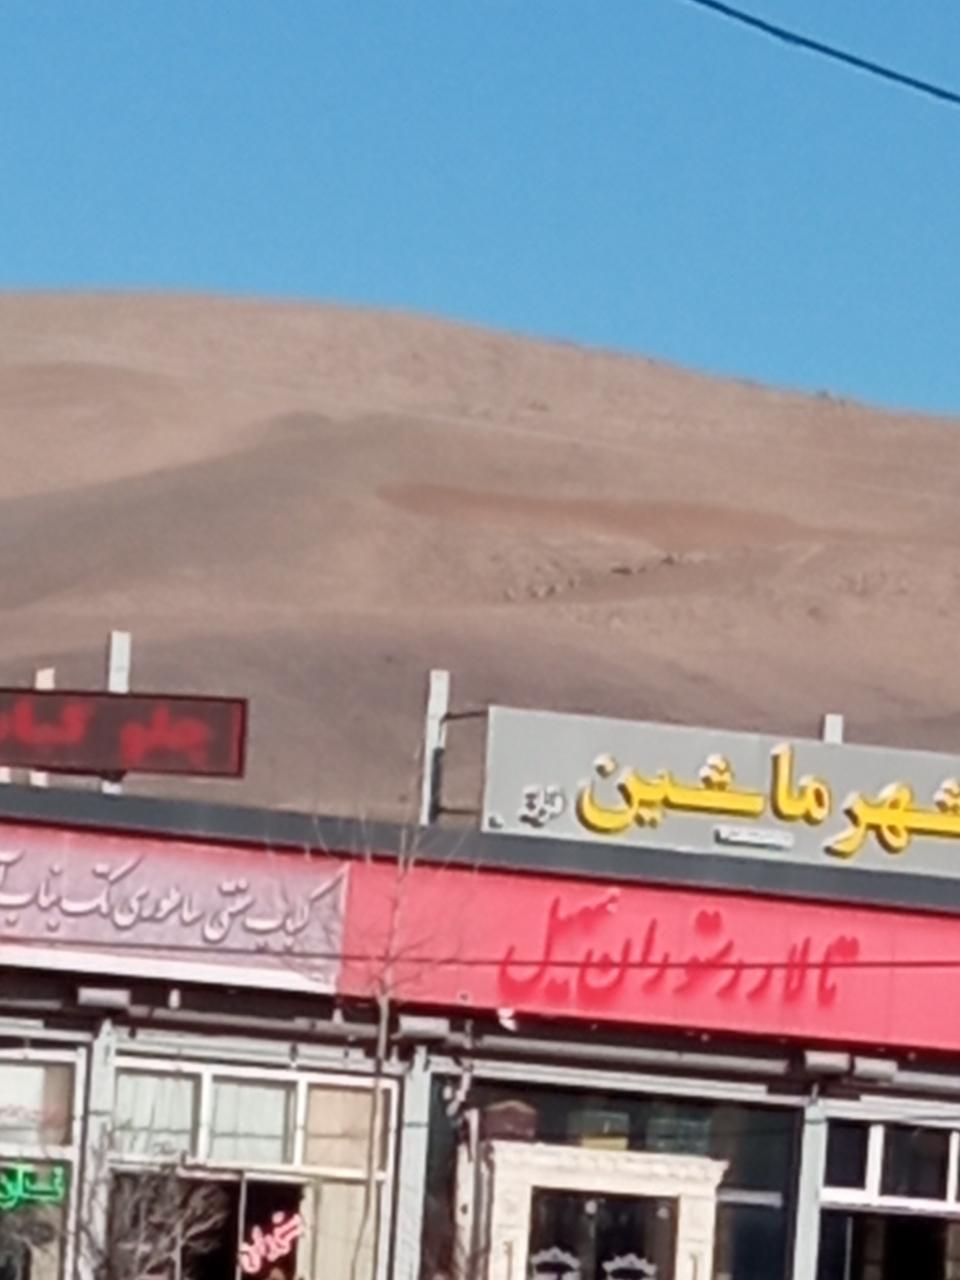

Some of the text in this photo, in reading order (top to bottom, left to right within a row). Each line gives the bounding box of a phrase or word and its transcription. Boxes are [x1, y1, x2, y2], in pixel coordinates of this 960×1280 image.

[576, 743, 835, 836] ماشین
[577, 908, 744, 1009] رستوران
[747, 934, 861, 1008] تالار
